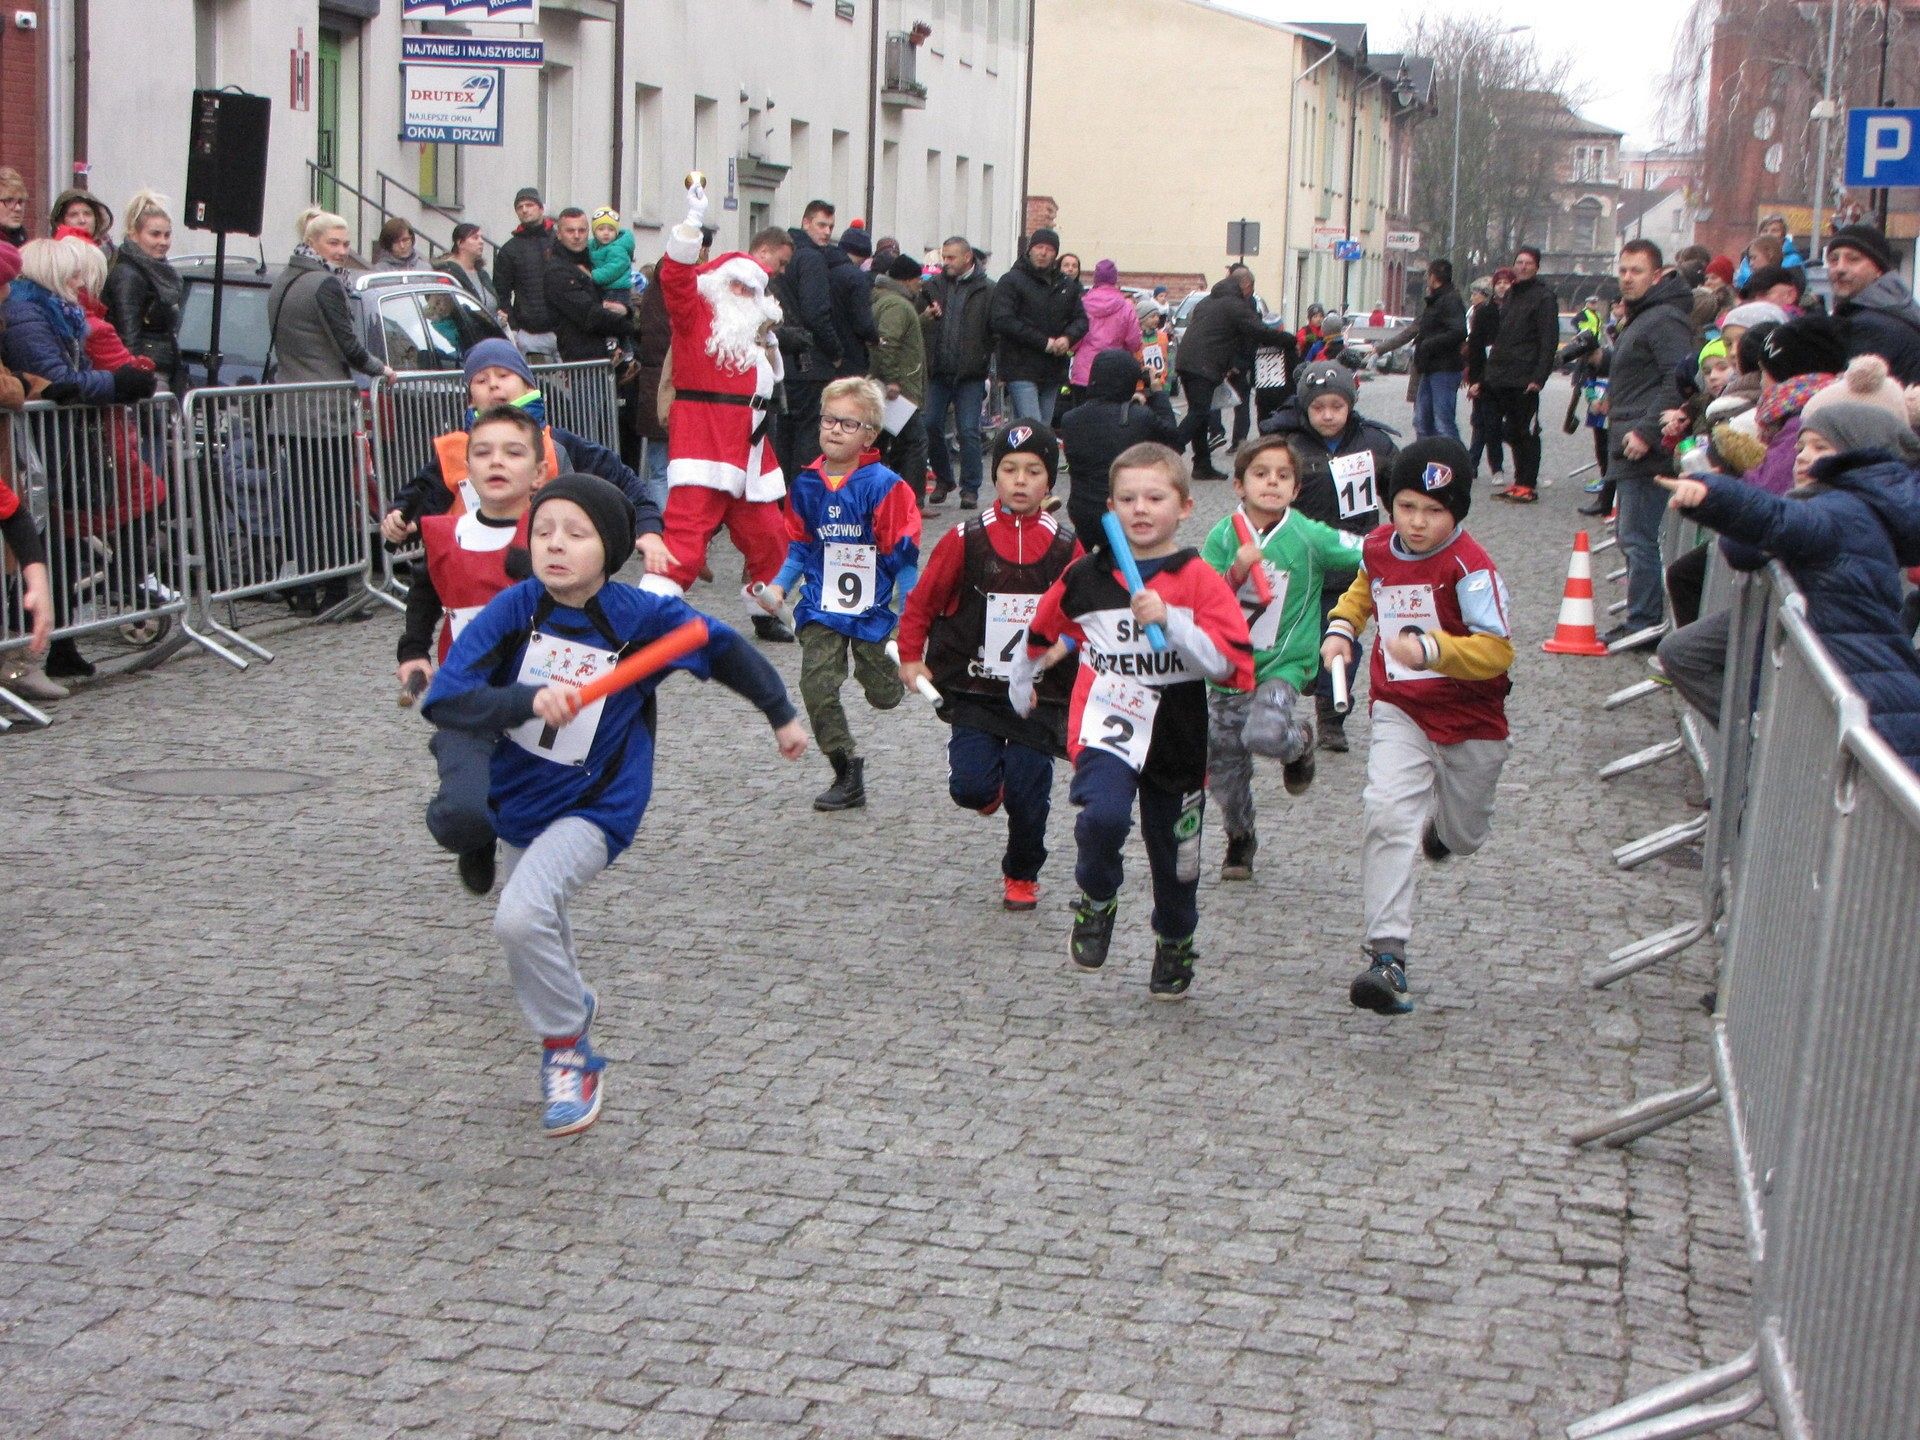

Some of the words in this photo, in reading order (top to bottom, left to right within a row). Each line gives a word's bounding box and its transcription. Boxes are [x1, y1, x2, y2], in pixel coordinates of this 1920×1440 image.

[406, 43, 460, 56] NAJTANIEJ
[468, 45, 540, 59] NAJSZYBCIEJ!
[411, 89, 475, 103] DRUTEX
[408, 112, 450, 122] NAJLEPSZE
[450, 114, 473, 123] OKNA
[407, 126, 446, 139] OKNA
[452, 128, 496, 142] DRZWI
[1862, 116, 1911, 178] P
[1341, 476, 1373, 512] 11
[828, 505, 841, 518] SP
[837, 572, 862, 609] 9
[1100, 714, 1134, 757] 2
